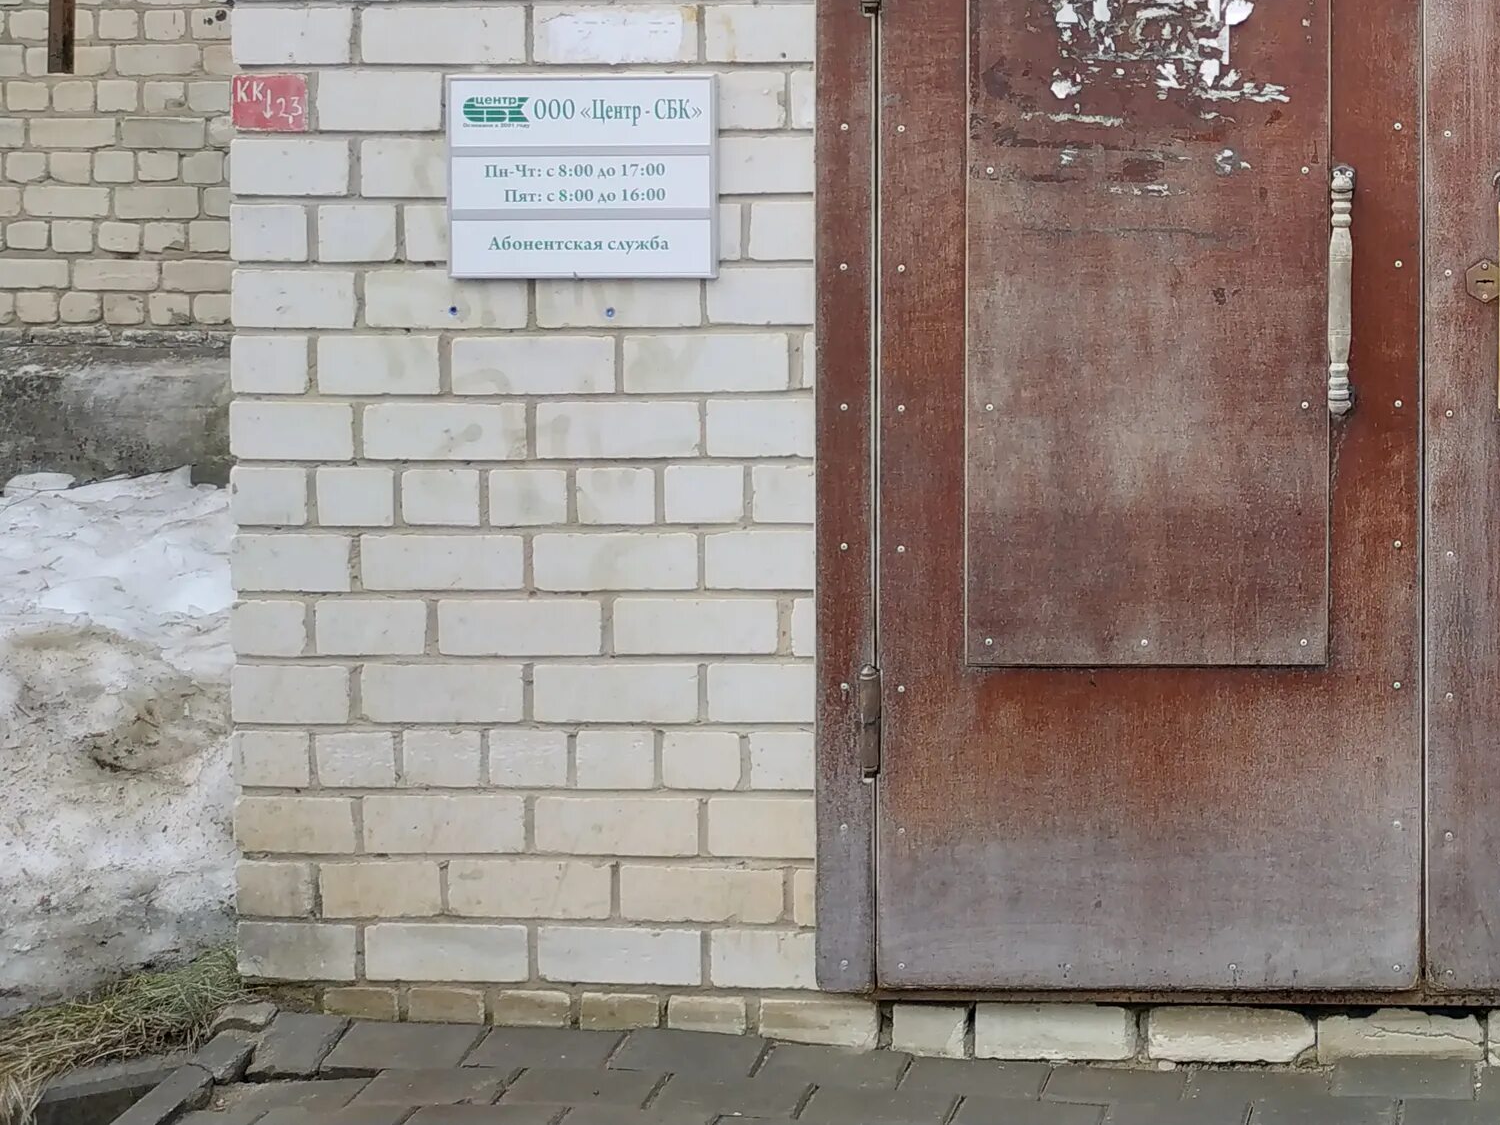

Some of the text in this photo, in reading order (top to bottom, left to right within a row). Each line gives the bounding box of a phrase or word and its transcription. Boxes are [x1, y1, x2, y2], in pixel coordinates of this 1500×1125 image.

[476, 96, 517, 106] центр
[534, 98, 575, 120] ООО
[580, 98, 642, 126] «Центр
[654, 98, 702, 120] СБК»
[484, 163, 666, 179] Пн-Чт: с 8:00 до 17:00
[504, 188, 666, 203] Пят: с 8:00 до 16:00
[488, 236, 670, 255] Абонентская служба
